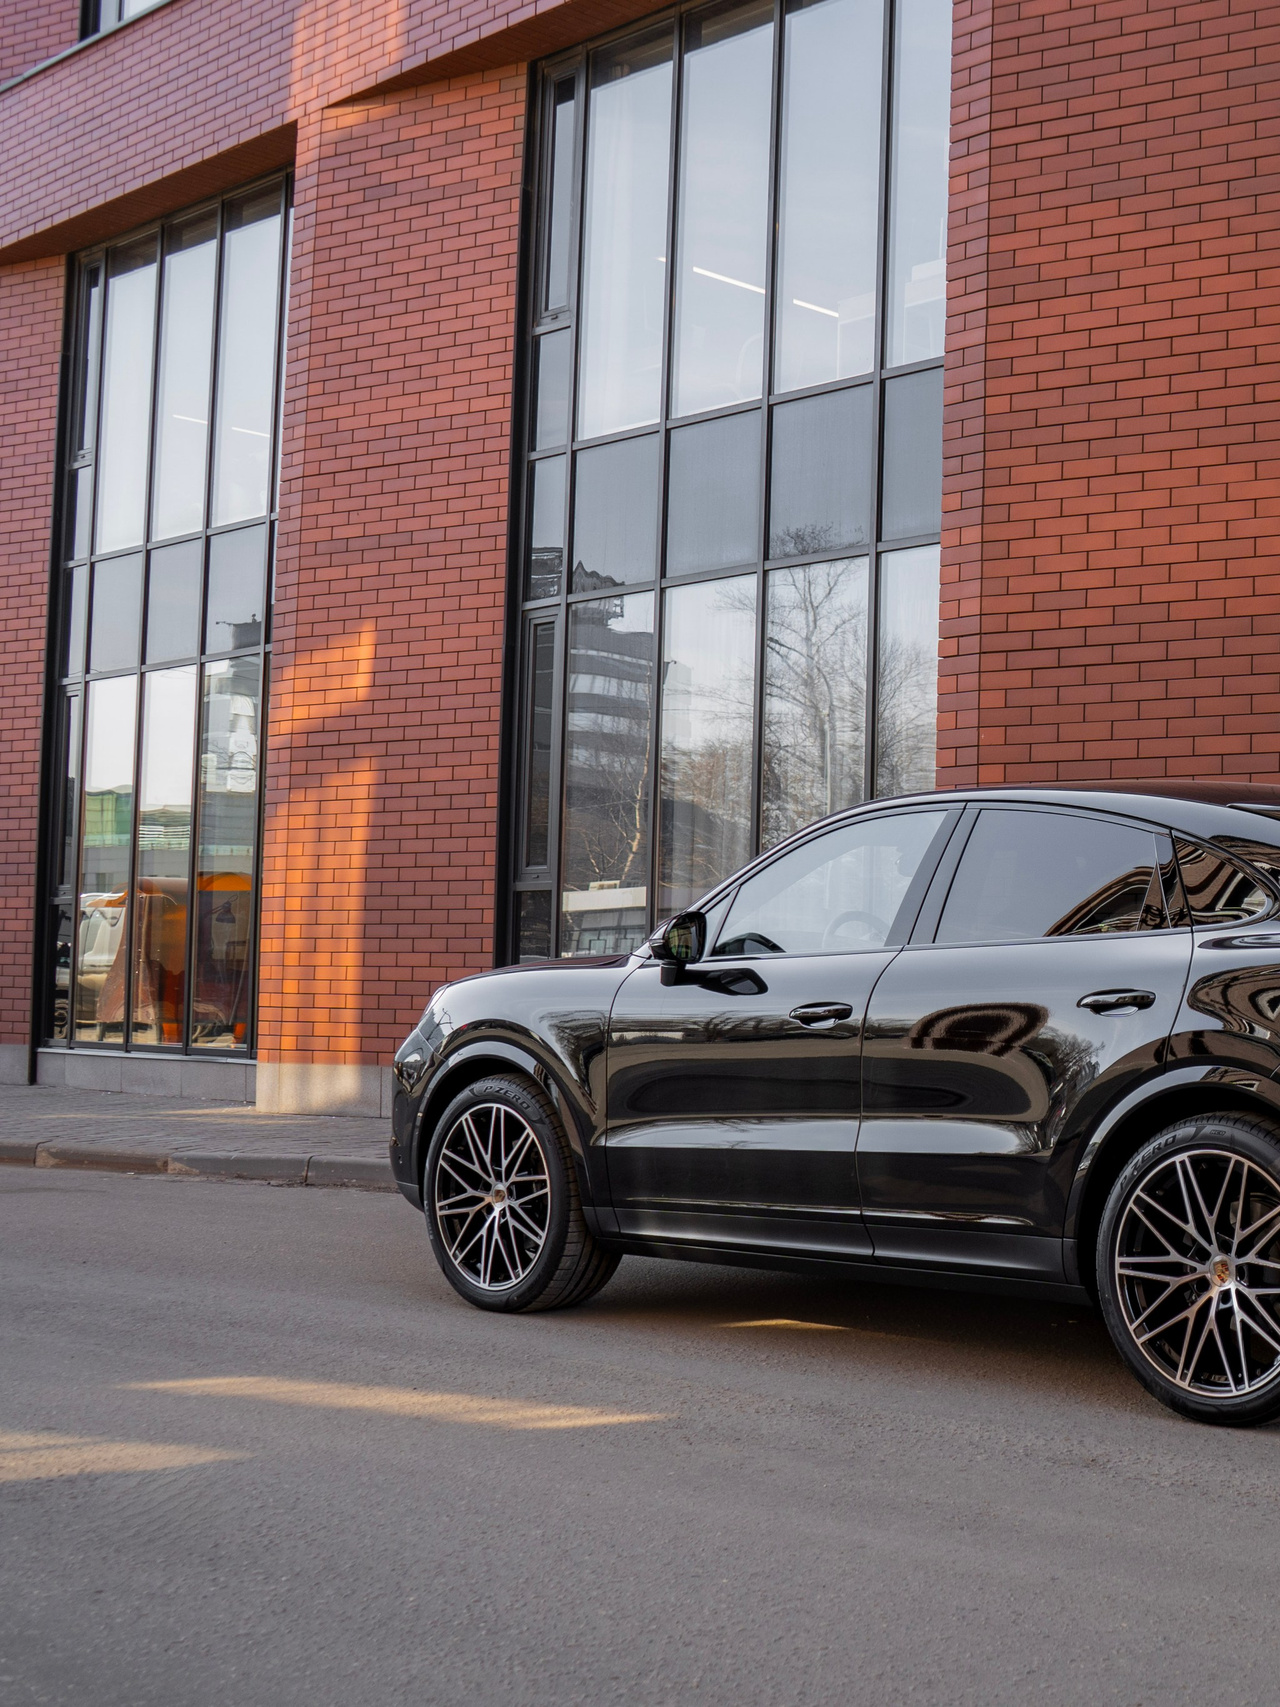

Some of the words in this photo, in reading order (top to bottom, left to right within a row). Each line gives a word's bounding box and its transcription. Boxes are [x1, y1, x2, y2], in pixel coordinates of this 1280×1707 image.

[484, 1085, 494, 1093] P
[495, 1086, 531, 1110] ZERO
[1119, 1174, 1127, 1191] P
[1130, 1134, 1177, 1175] ZERO
